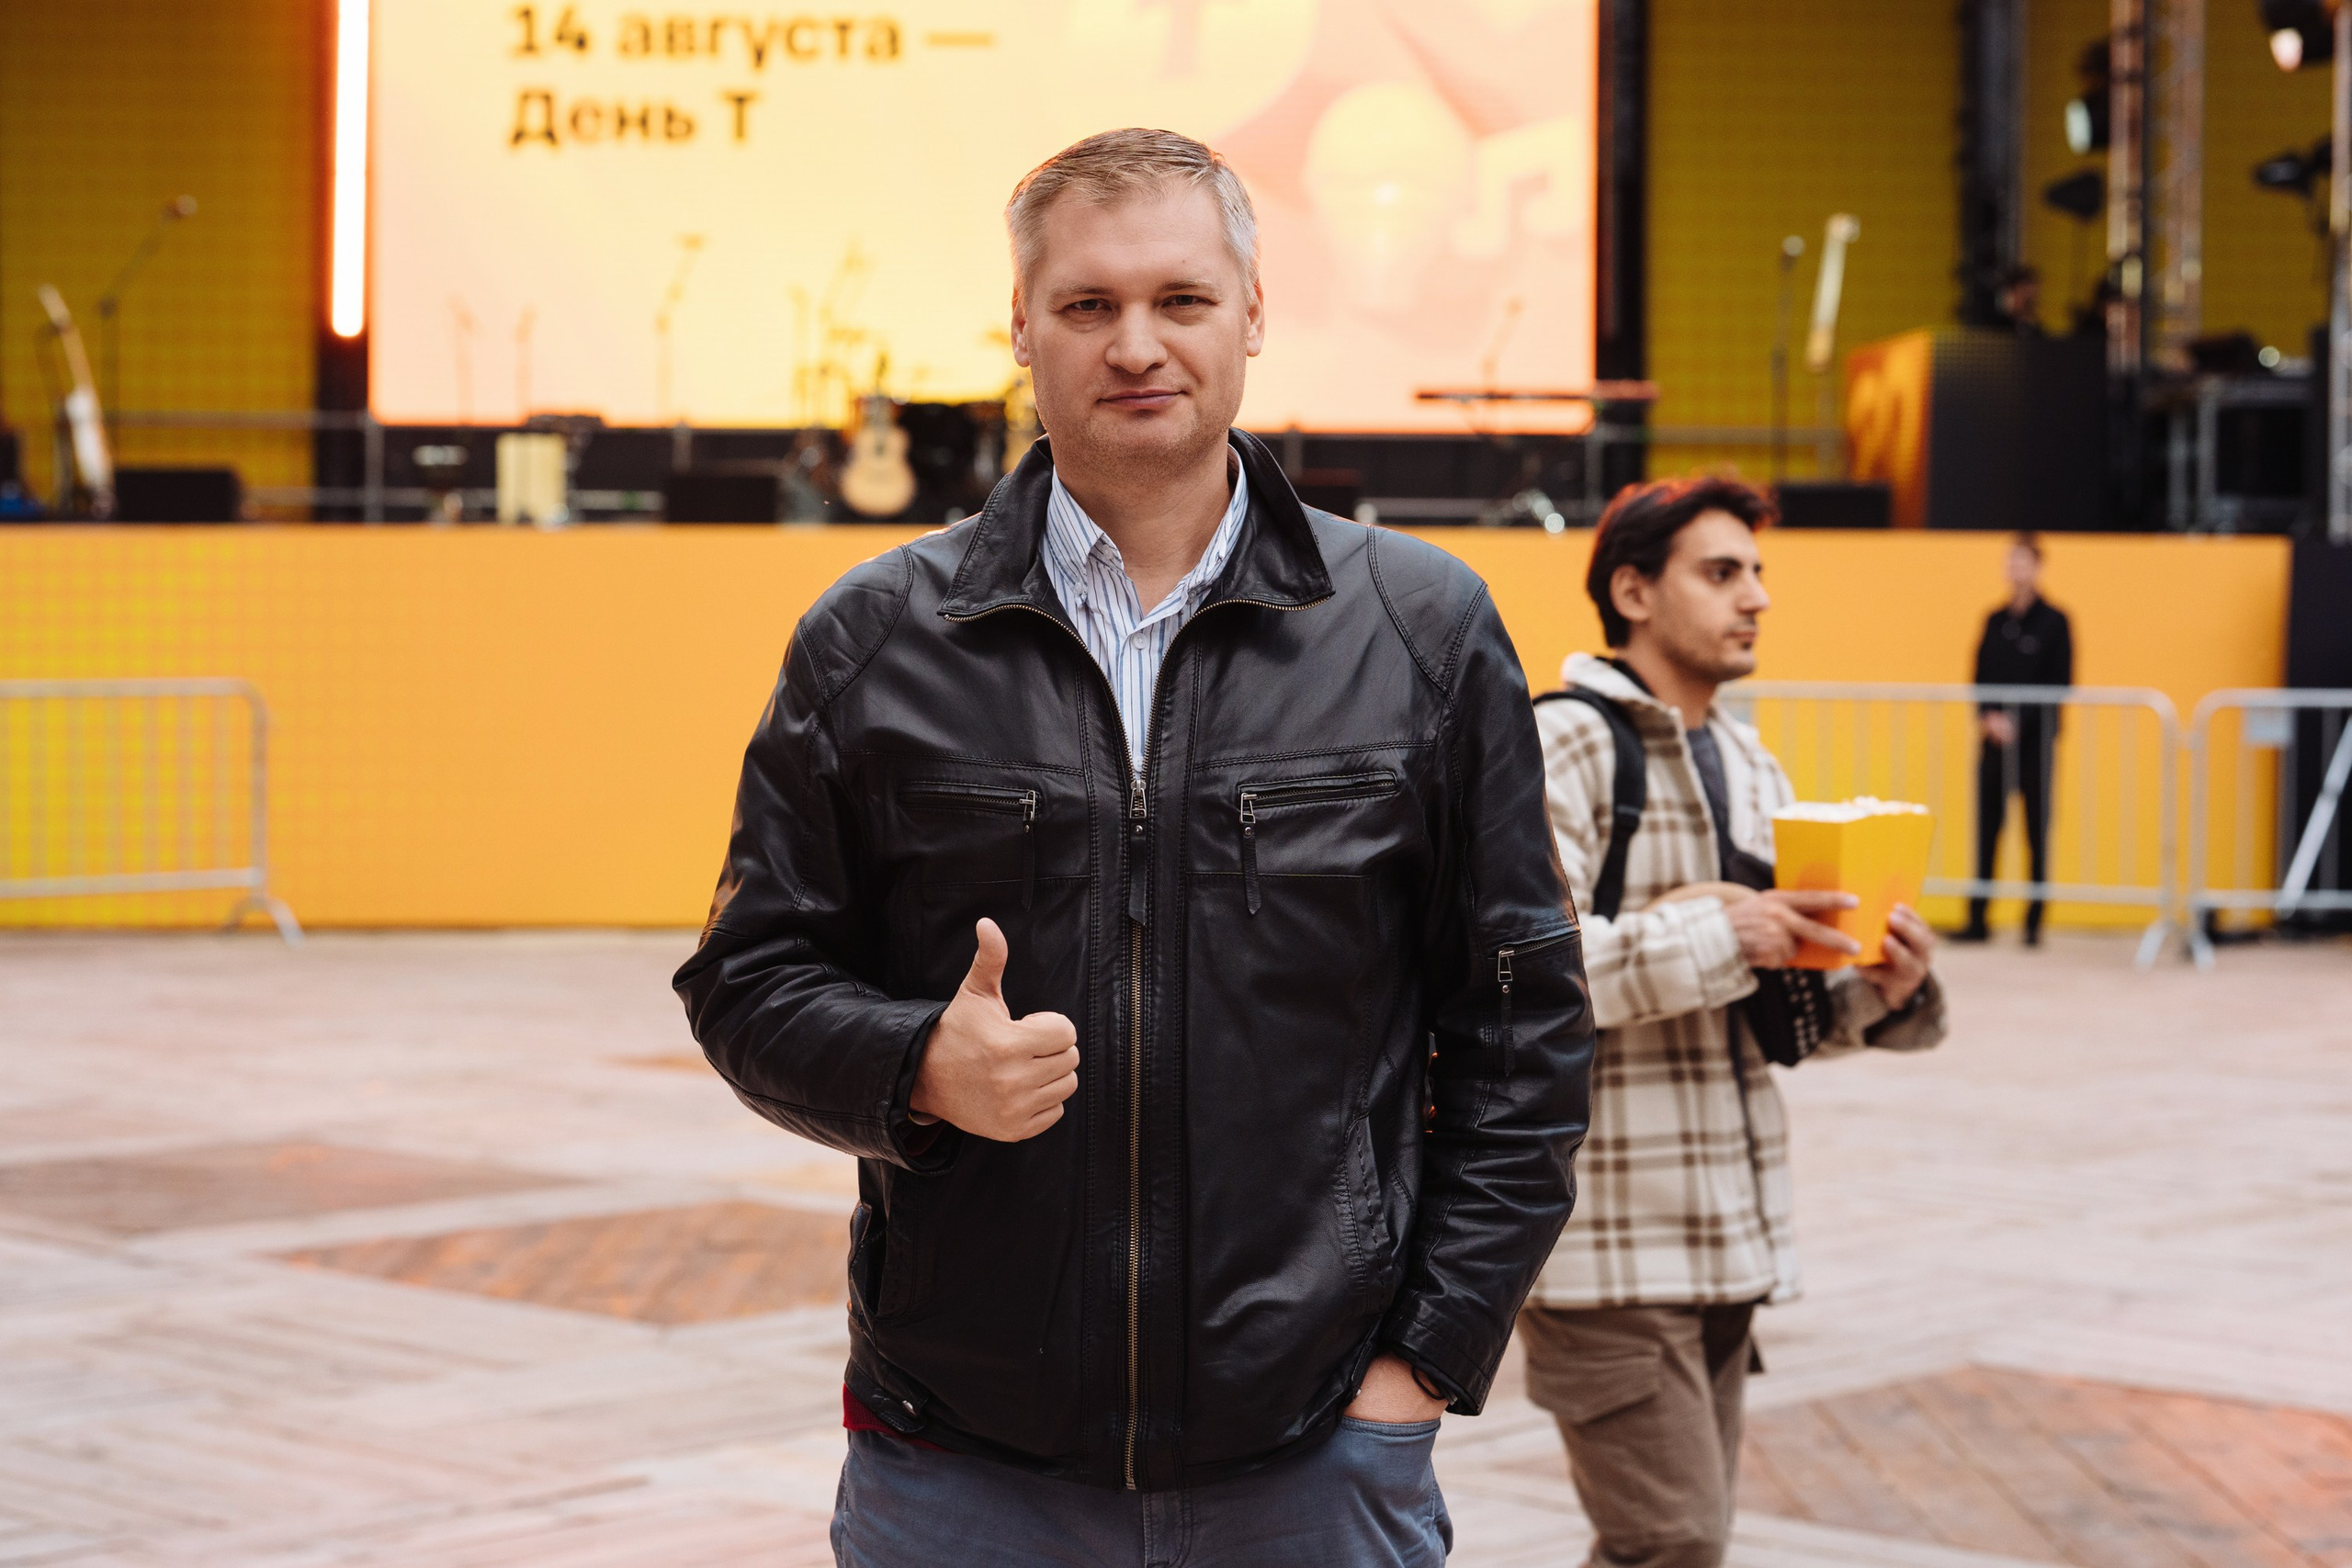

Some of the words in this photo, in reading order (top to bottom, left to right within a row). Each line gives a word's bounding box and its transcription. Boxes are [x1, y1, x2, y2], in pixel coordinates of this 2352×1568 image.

[511, 4, 589, 58] 14
[617, 14, 901, 69] августа
[509, 89, 695, 146] День
